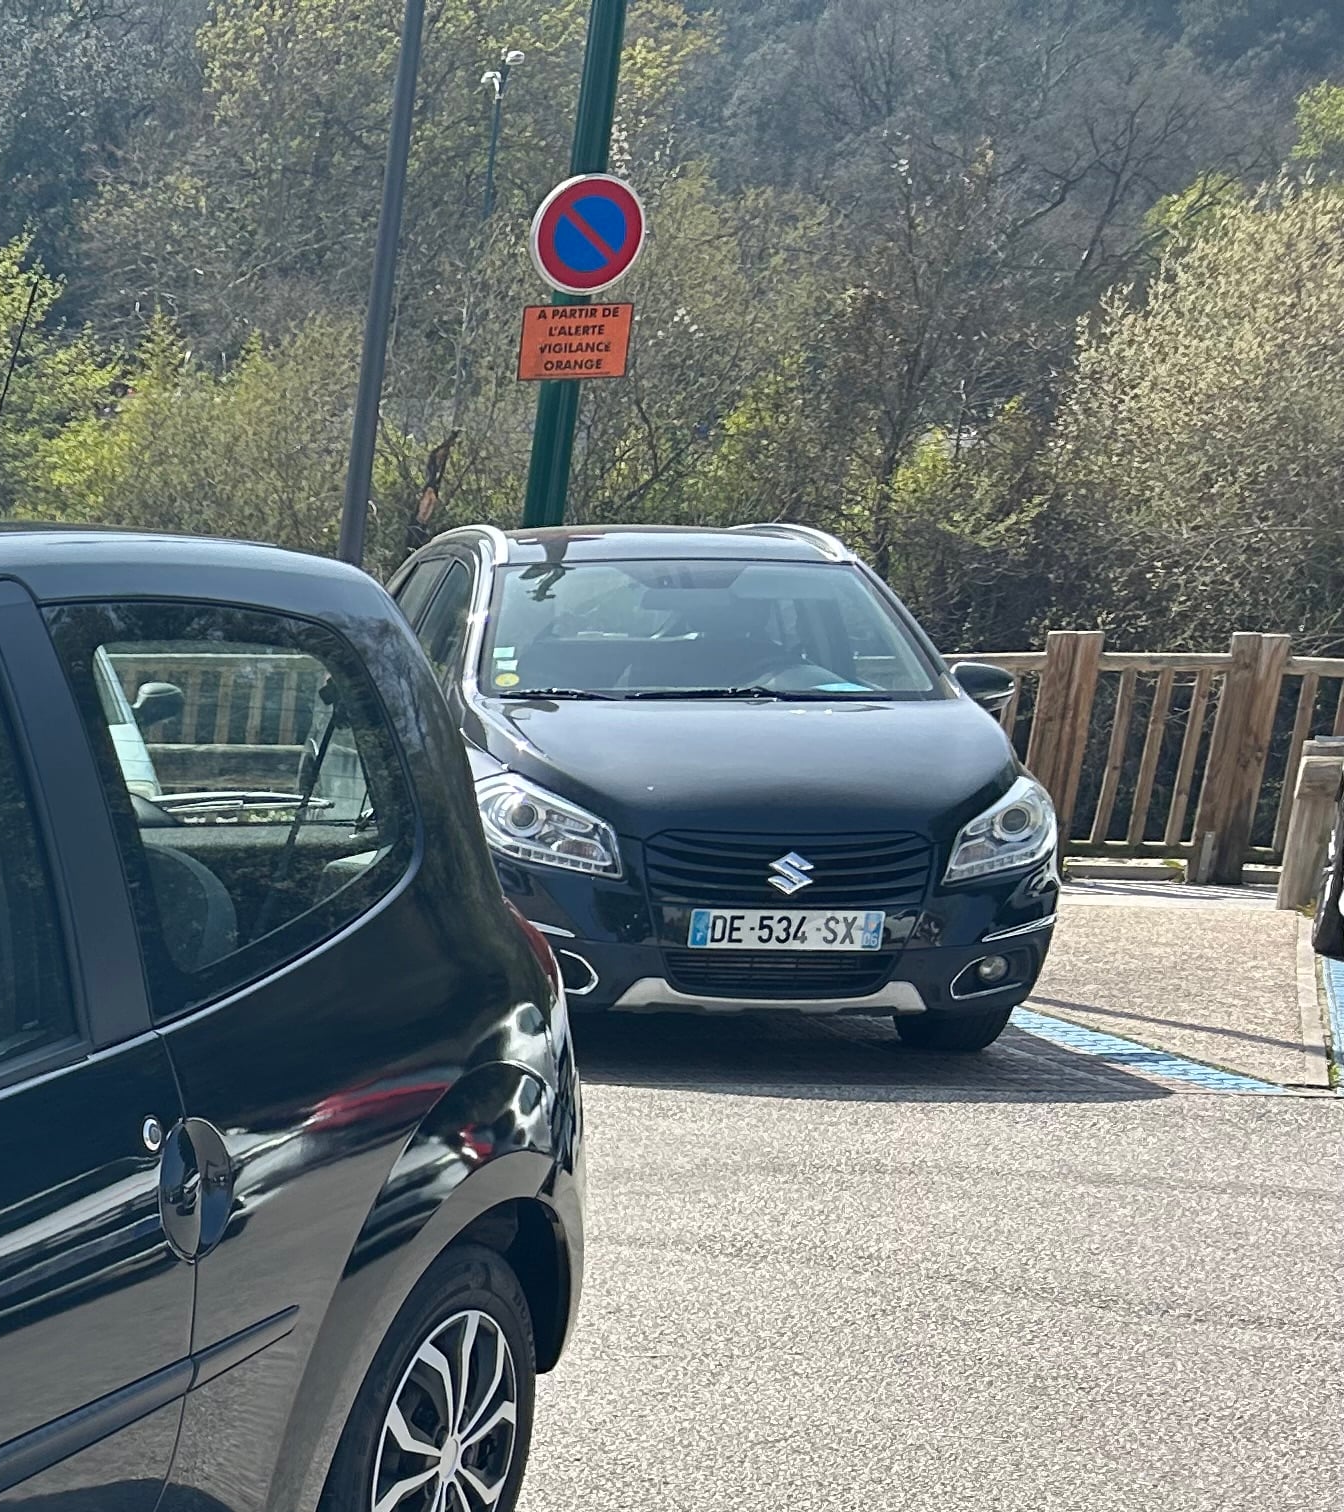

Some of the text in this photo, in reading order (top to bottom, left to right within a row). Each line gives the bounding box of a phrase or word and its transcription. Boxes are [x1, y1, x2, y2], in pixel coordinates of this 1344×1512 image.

[537, 307, 620, 320] A PARTIR DE
[548, 325, 605, 337] L'ALERTE
[539, 342, 611, 354] VIGILANCE
[544, 359, 603, 371] ORANGE
